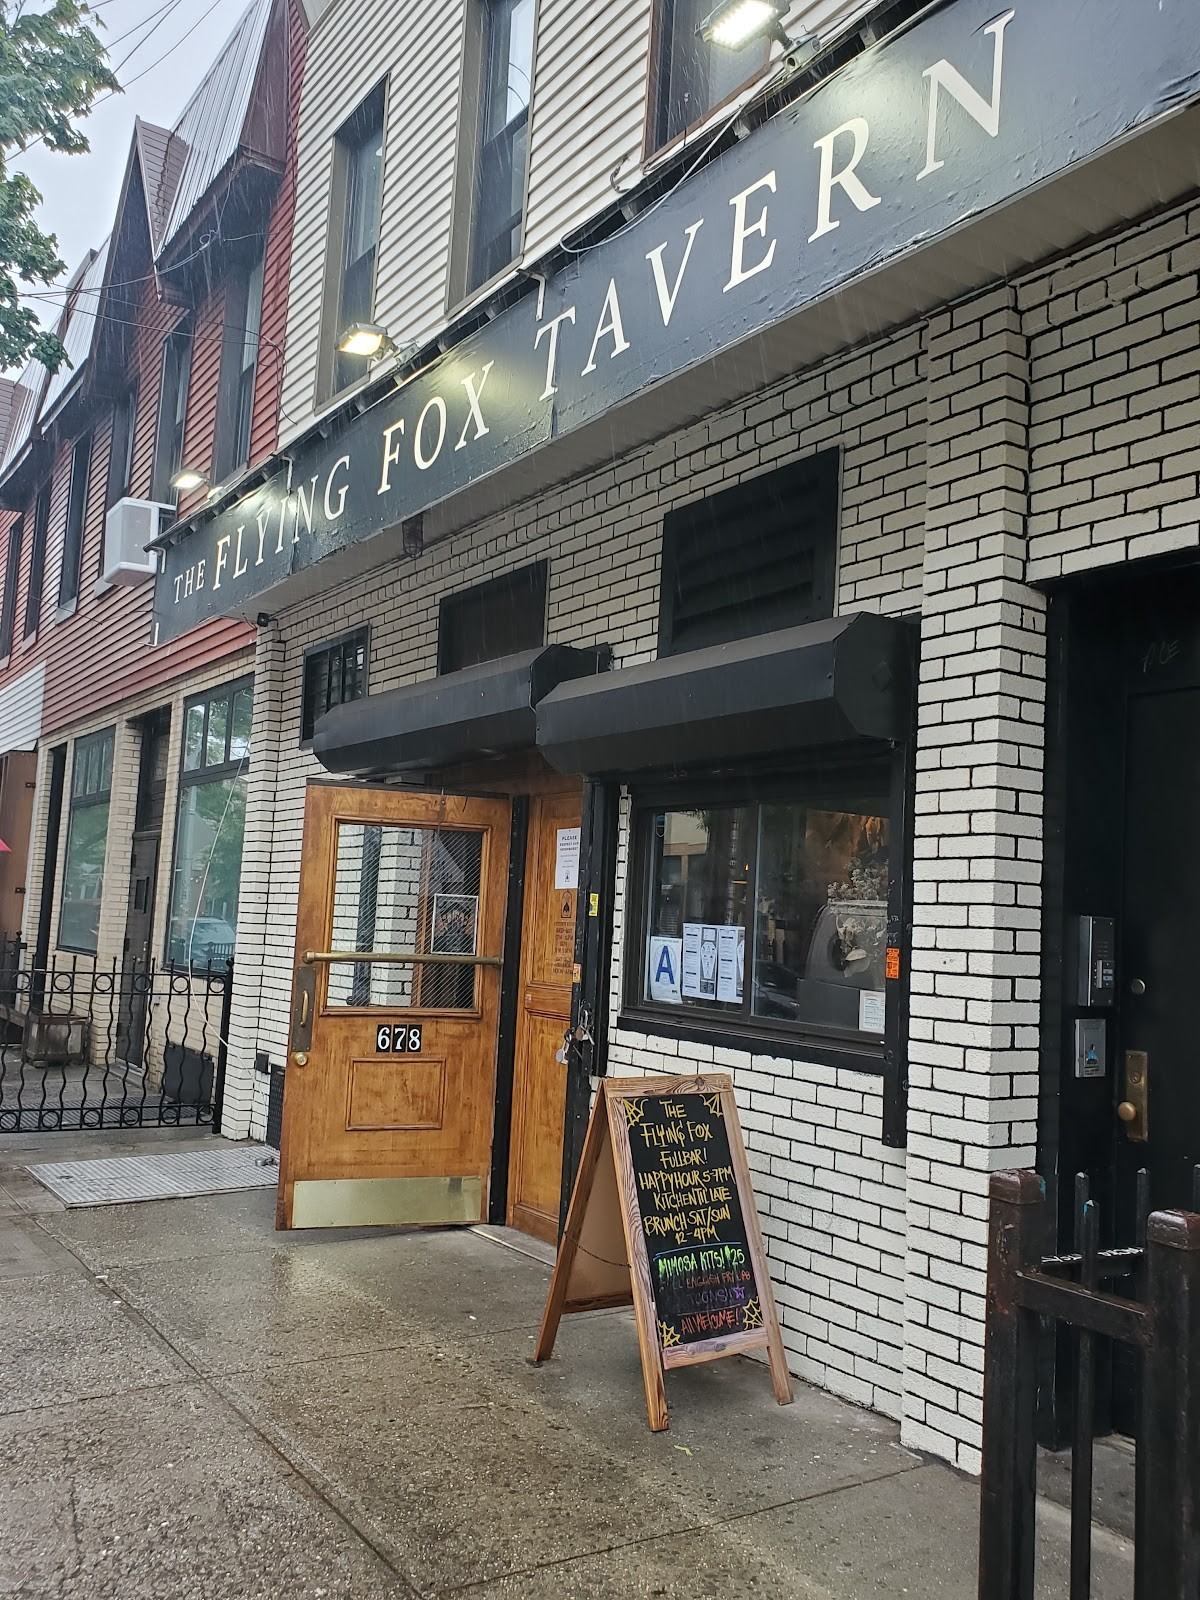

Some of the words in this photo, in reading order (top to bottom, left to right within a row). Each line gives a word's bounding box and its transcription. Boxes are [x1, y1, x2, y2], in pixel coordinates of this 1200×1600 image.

[174, 558, 206, 604] THE
[212, 455, 350, 591] FLYING
[377, 359, 495, 495] FOX
[534, 9, 1016, 401] TAVERN
[654, 945, 675, 985] A
[376, 1025, 422, 1052] 678
[659, 1098, 687, 1118] THE
[639, 1119, 686, 1148] FLYING
[686, 1120, 713, 1142] FOX
[702, 1165, 736, 1185] 5-7PM
[709, 1186, 732, 1203] LATE
[643, 1211, 688, 1237] BRUNCH
[658, 1252, 698, 1278] MIMOSA
